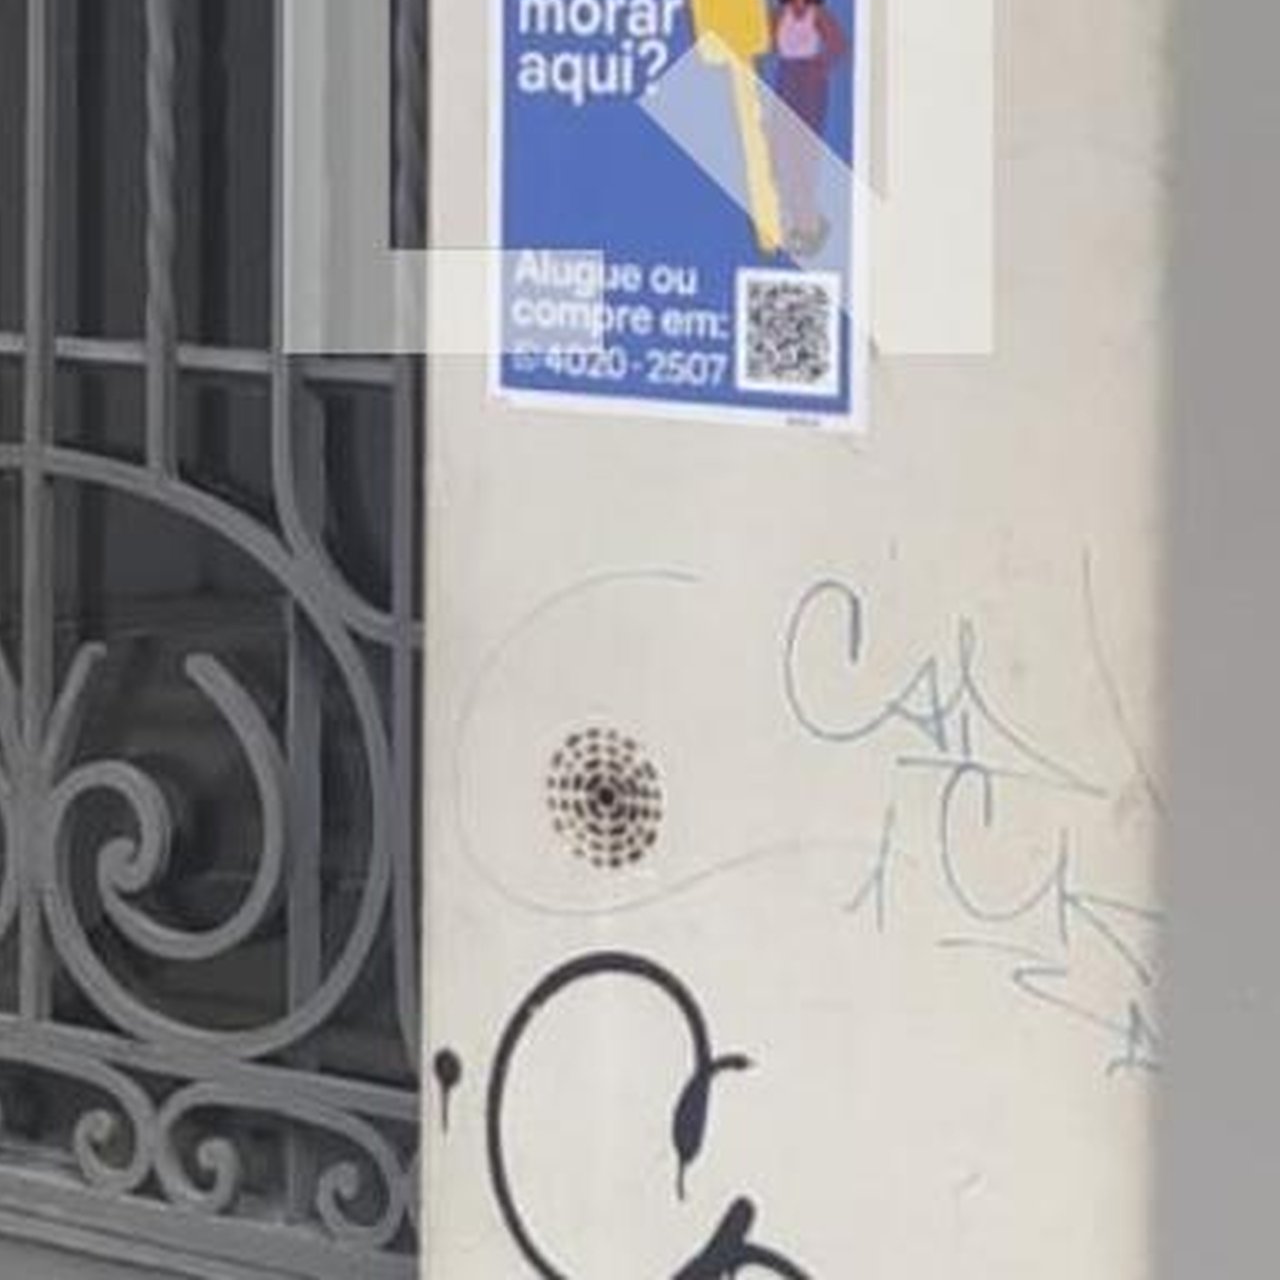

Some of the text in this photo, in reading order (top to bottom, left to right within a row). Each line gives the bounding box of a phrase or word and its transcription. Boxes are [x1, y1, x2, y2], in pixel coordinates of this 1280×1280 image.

[518, 40, 669, 107] aqui?
[515, 249, 699, 297] Alugue ou
[512, 298, 654, 339] compre
